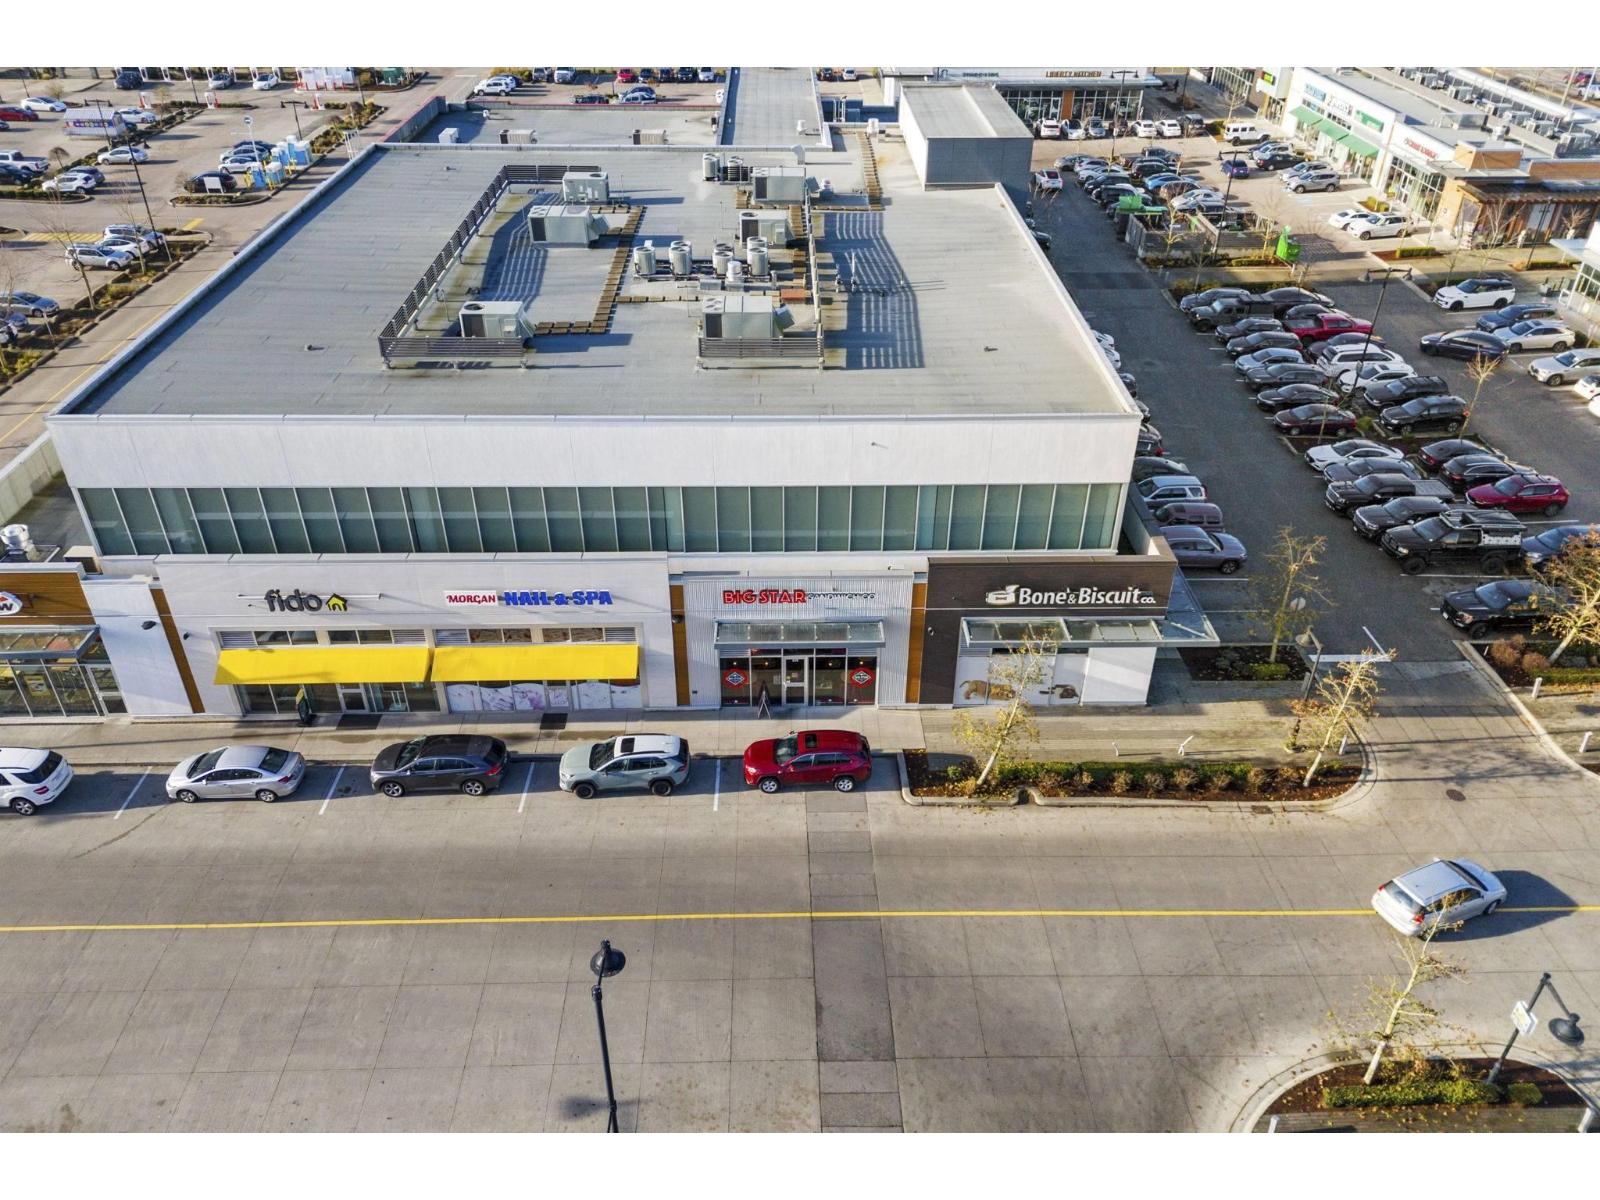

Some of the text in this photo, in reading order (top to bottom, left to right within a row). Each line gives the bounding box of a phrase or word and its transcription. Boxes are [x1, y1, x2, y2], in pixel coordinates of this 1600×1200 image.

[264, 589, 322, 612] fido
[447, 590, 613, 606] MORGAN NAIL & SPA
[723, 590, 756, 604] BIG
[758, 589, 807, 604] STAR
[1077, 586, 1141, 604] Biscuit
